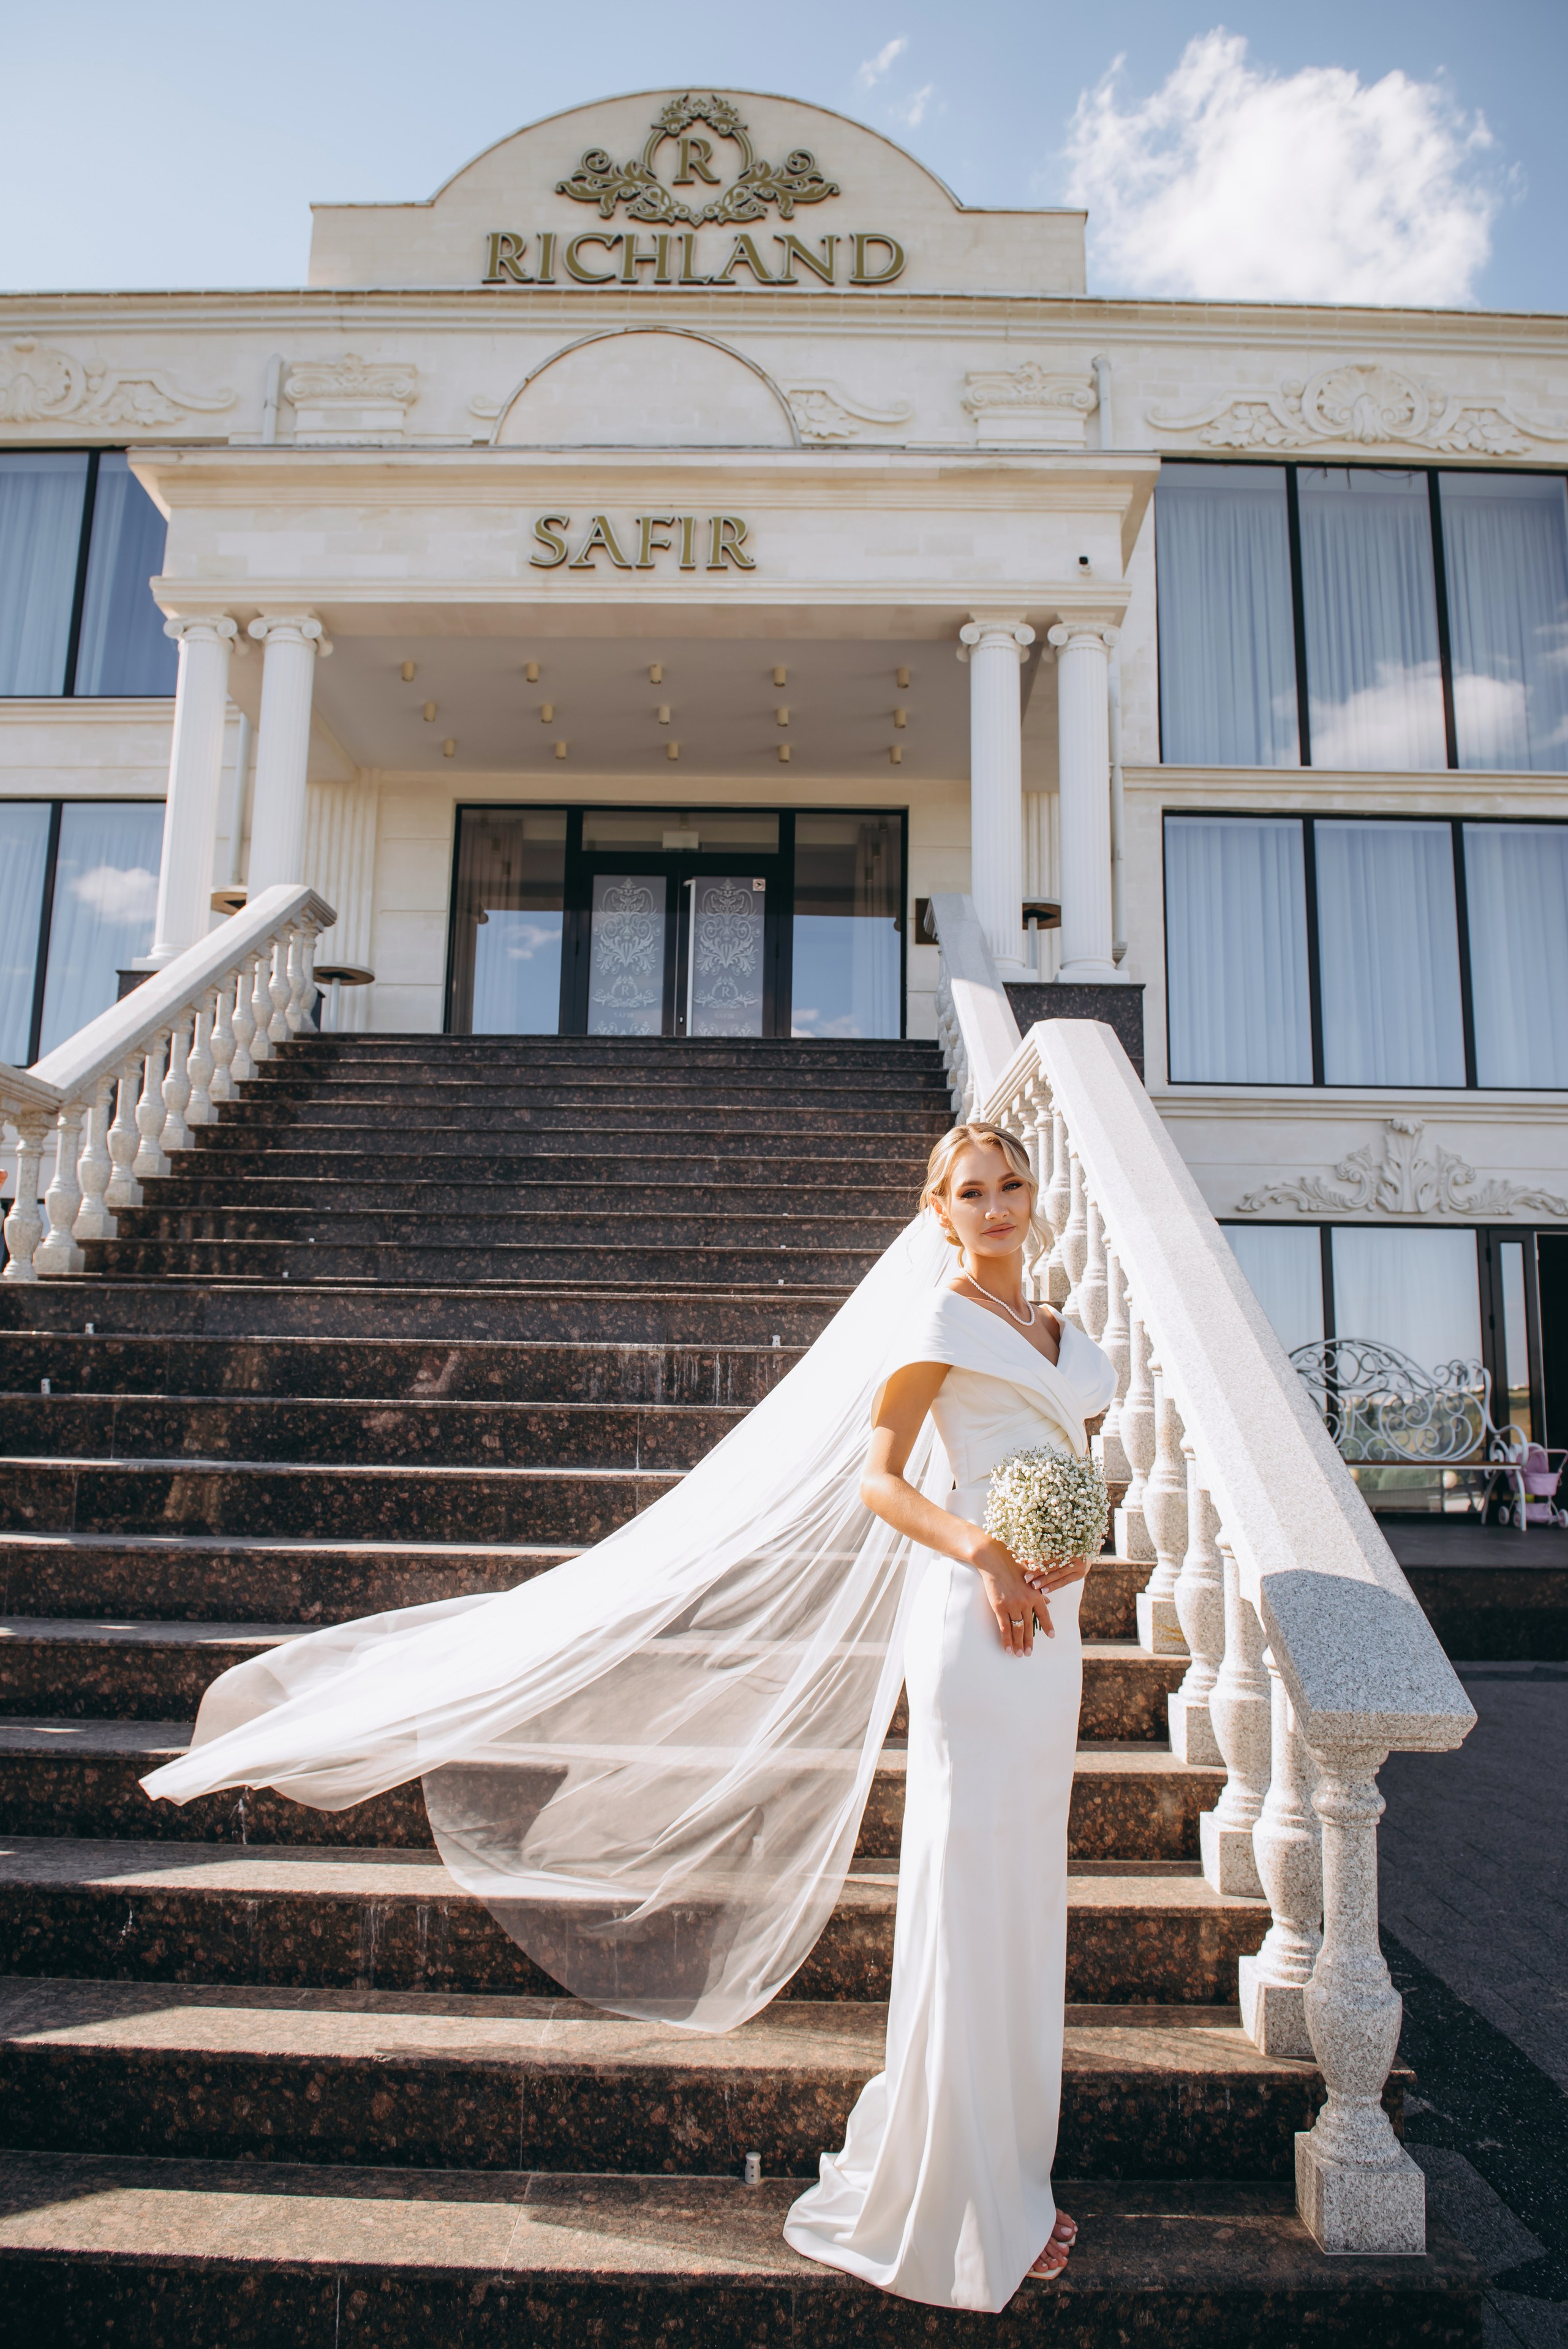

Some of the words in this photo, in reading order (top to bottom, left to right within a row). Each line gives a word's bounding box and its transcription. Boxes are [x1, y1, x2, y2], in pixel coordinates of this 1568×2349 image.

[673, 136, 721, 185] R
[481, 232, 908, 285] RICHLAND
[528, 514, 756, 568] SAFIR
[621, 986, 630, 996] R
[722, 986, 730, 997] R
